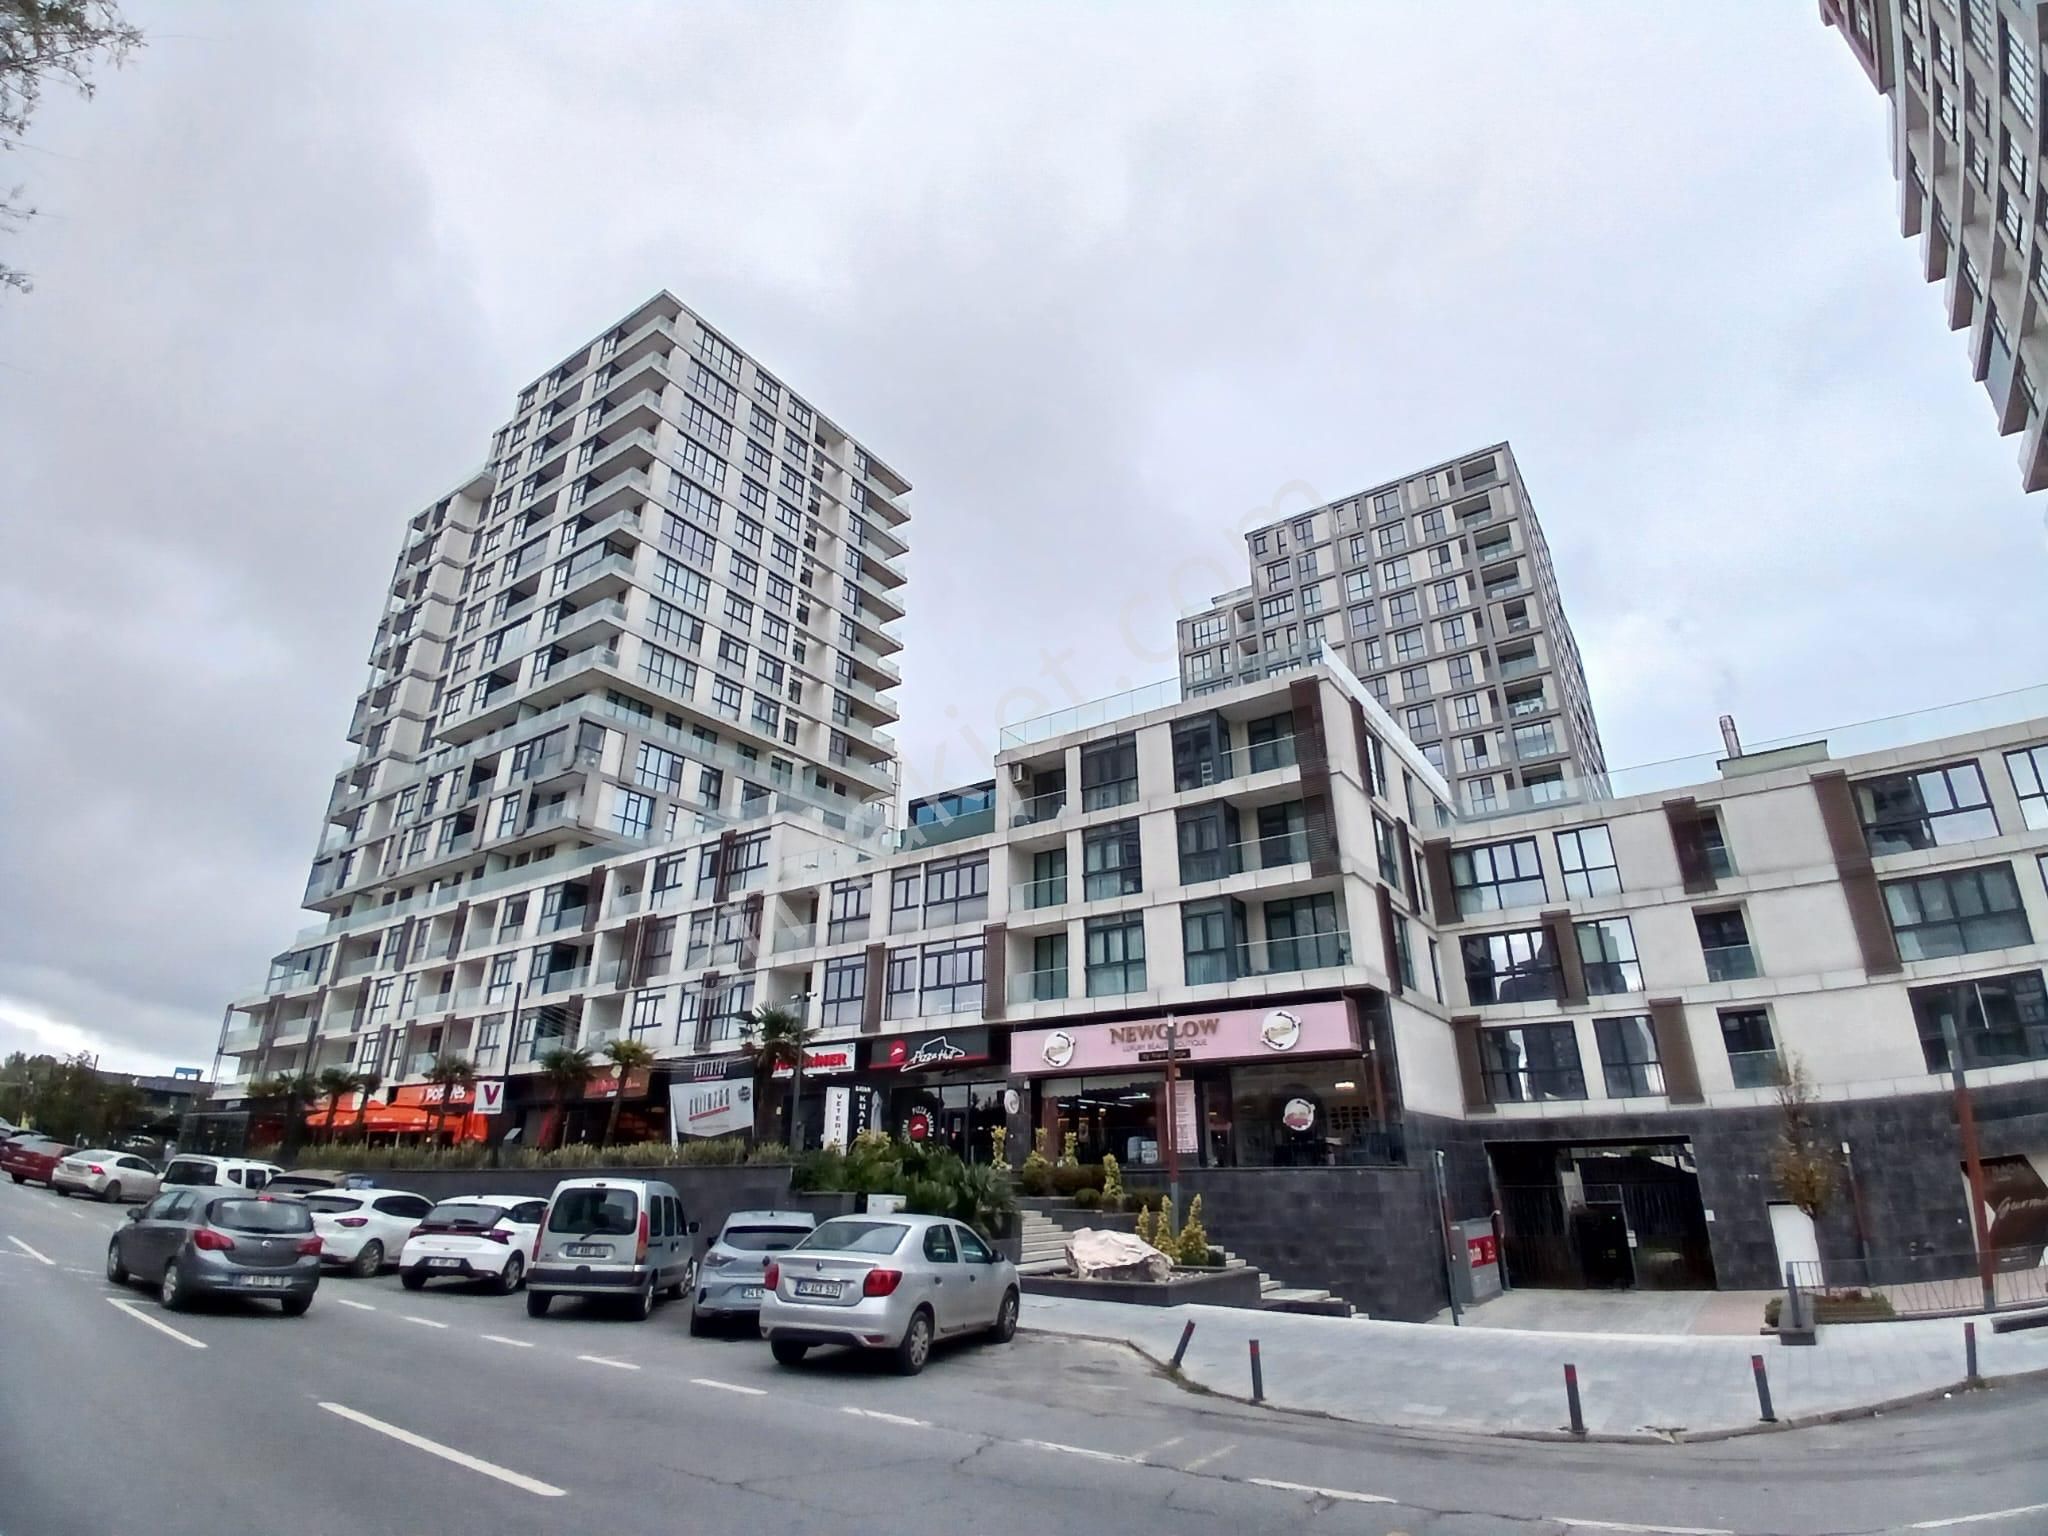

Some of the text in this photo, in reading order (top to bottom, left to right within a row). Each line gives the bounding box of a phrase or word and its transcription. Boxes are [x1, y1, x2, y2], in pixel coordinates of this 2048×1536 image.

[1147, 1041, 1170, 1050] BEAUT
[909, 1048, 954, 1064] Pizza Hut
[484, 1084, 501, 1105] V
